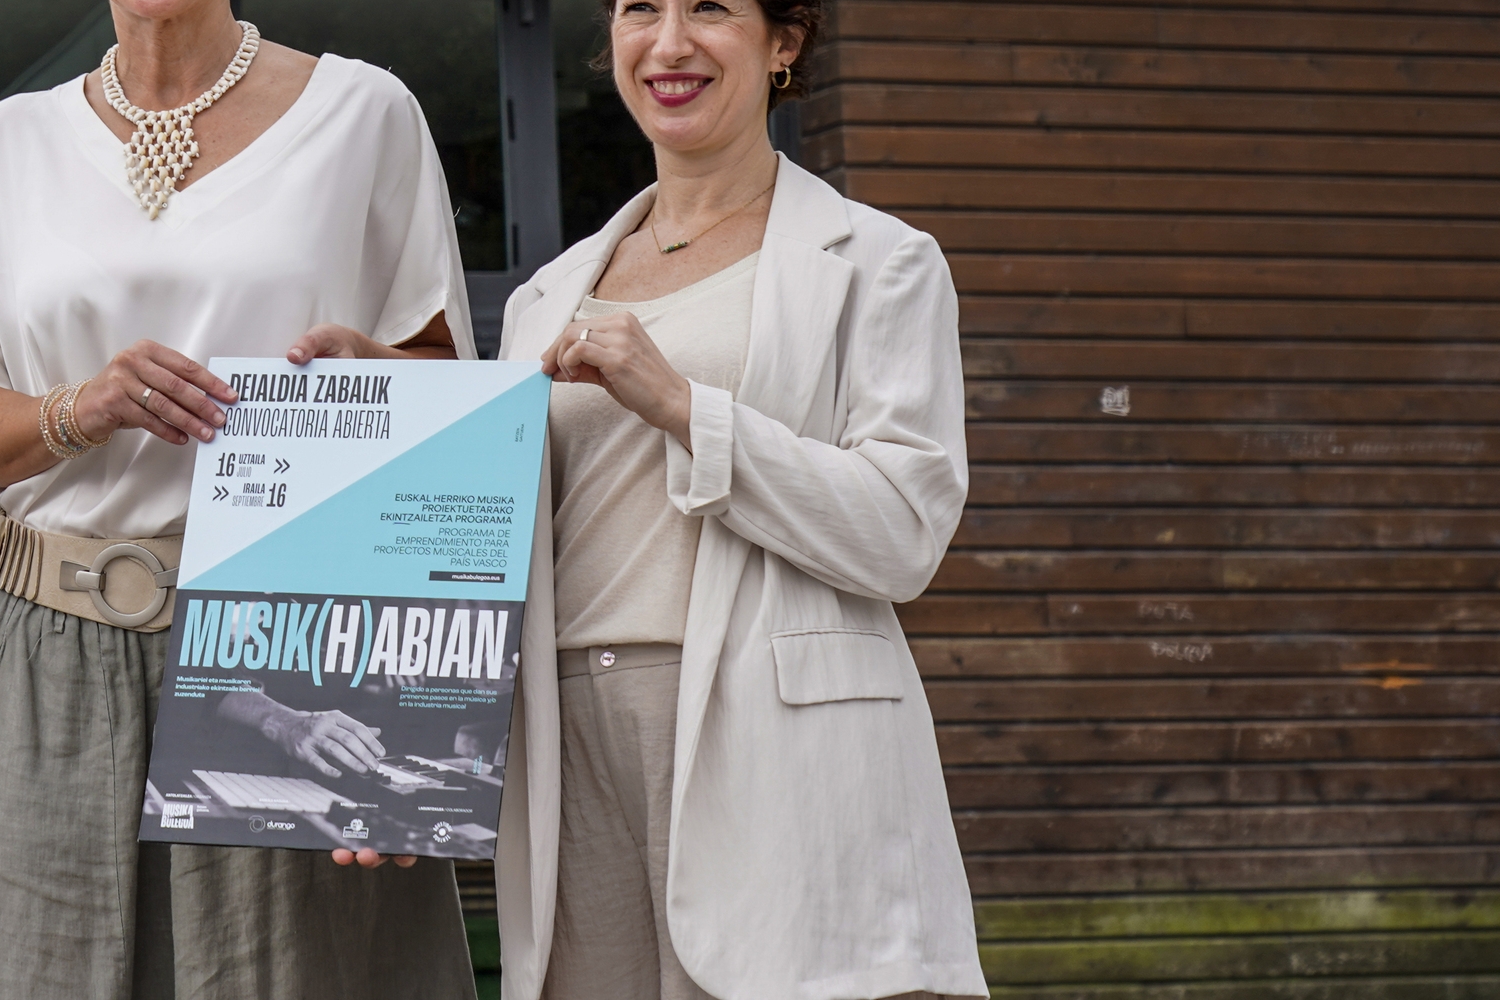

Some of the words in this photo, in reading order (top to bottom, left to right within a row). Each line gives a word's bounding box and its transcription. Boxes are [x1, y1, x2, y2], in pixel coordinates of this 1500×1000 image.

[230, 373, 308, 402] DEIALDIA
[313, 375, 392, 404] ZABALIK
[223, 407, 328, 438] CONVOCATORIA
[333, 410, 390, 440] ABIERTA
[215, 453, 235, 477] 16
[238, 454, 266, 465] UZTAILA
[236, 466, 252, 478] JULIO
[231, 495, 265, 508] SEPTIEMBRE
[242, 483, 266, 494] IRAILA
[266, 483, 287, 508] 16
[395, 493, 431, 502] EUSKAL
[433, 495, 475, 504] HERRIKO
[476, 496, 515, 505] MUSIKA
[422, 504, 514, 515] PROIEKTUETARAKO
[380, 512, 453, 523] EKINTZAILETZA
[455, 515, 513, 525] PROGRAMA
[438, 528, 495, 538] PROGRAMA
[497, 529, 511, 538] DE
[395, 536, 482, 547] EMPRENDIMIENTO
[484, 539, 510, 548] PARA
[373, 545, 431, 556] PROYECTOS
[433, 547, 488, 557] MUSICALES
[489, 549, 508, 558] DEL
[450, 556, 471, 567] PAÍS
[472, 559, 507, 568] VASCO
[451, 573, 501, 582] musikabulegoa.eus
[179, 598, 509, 688] MUSIK(H)ABIAN
[162, 803, 193, 817] MUSIKA
[267, 820, 295, 831] durango
